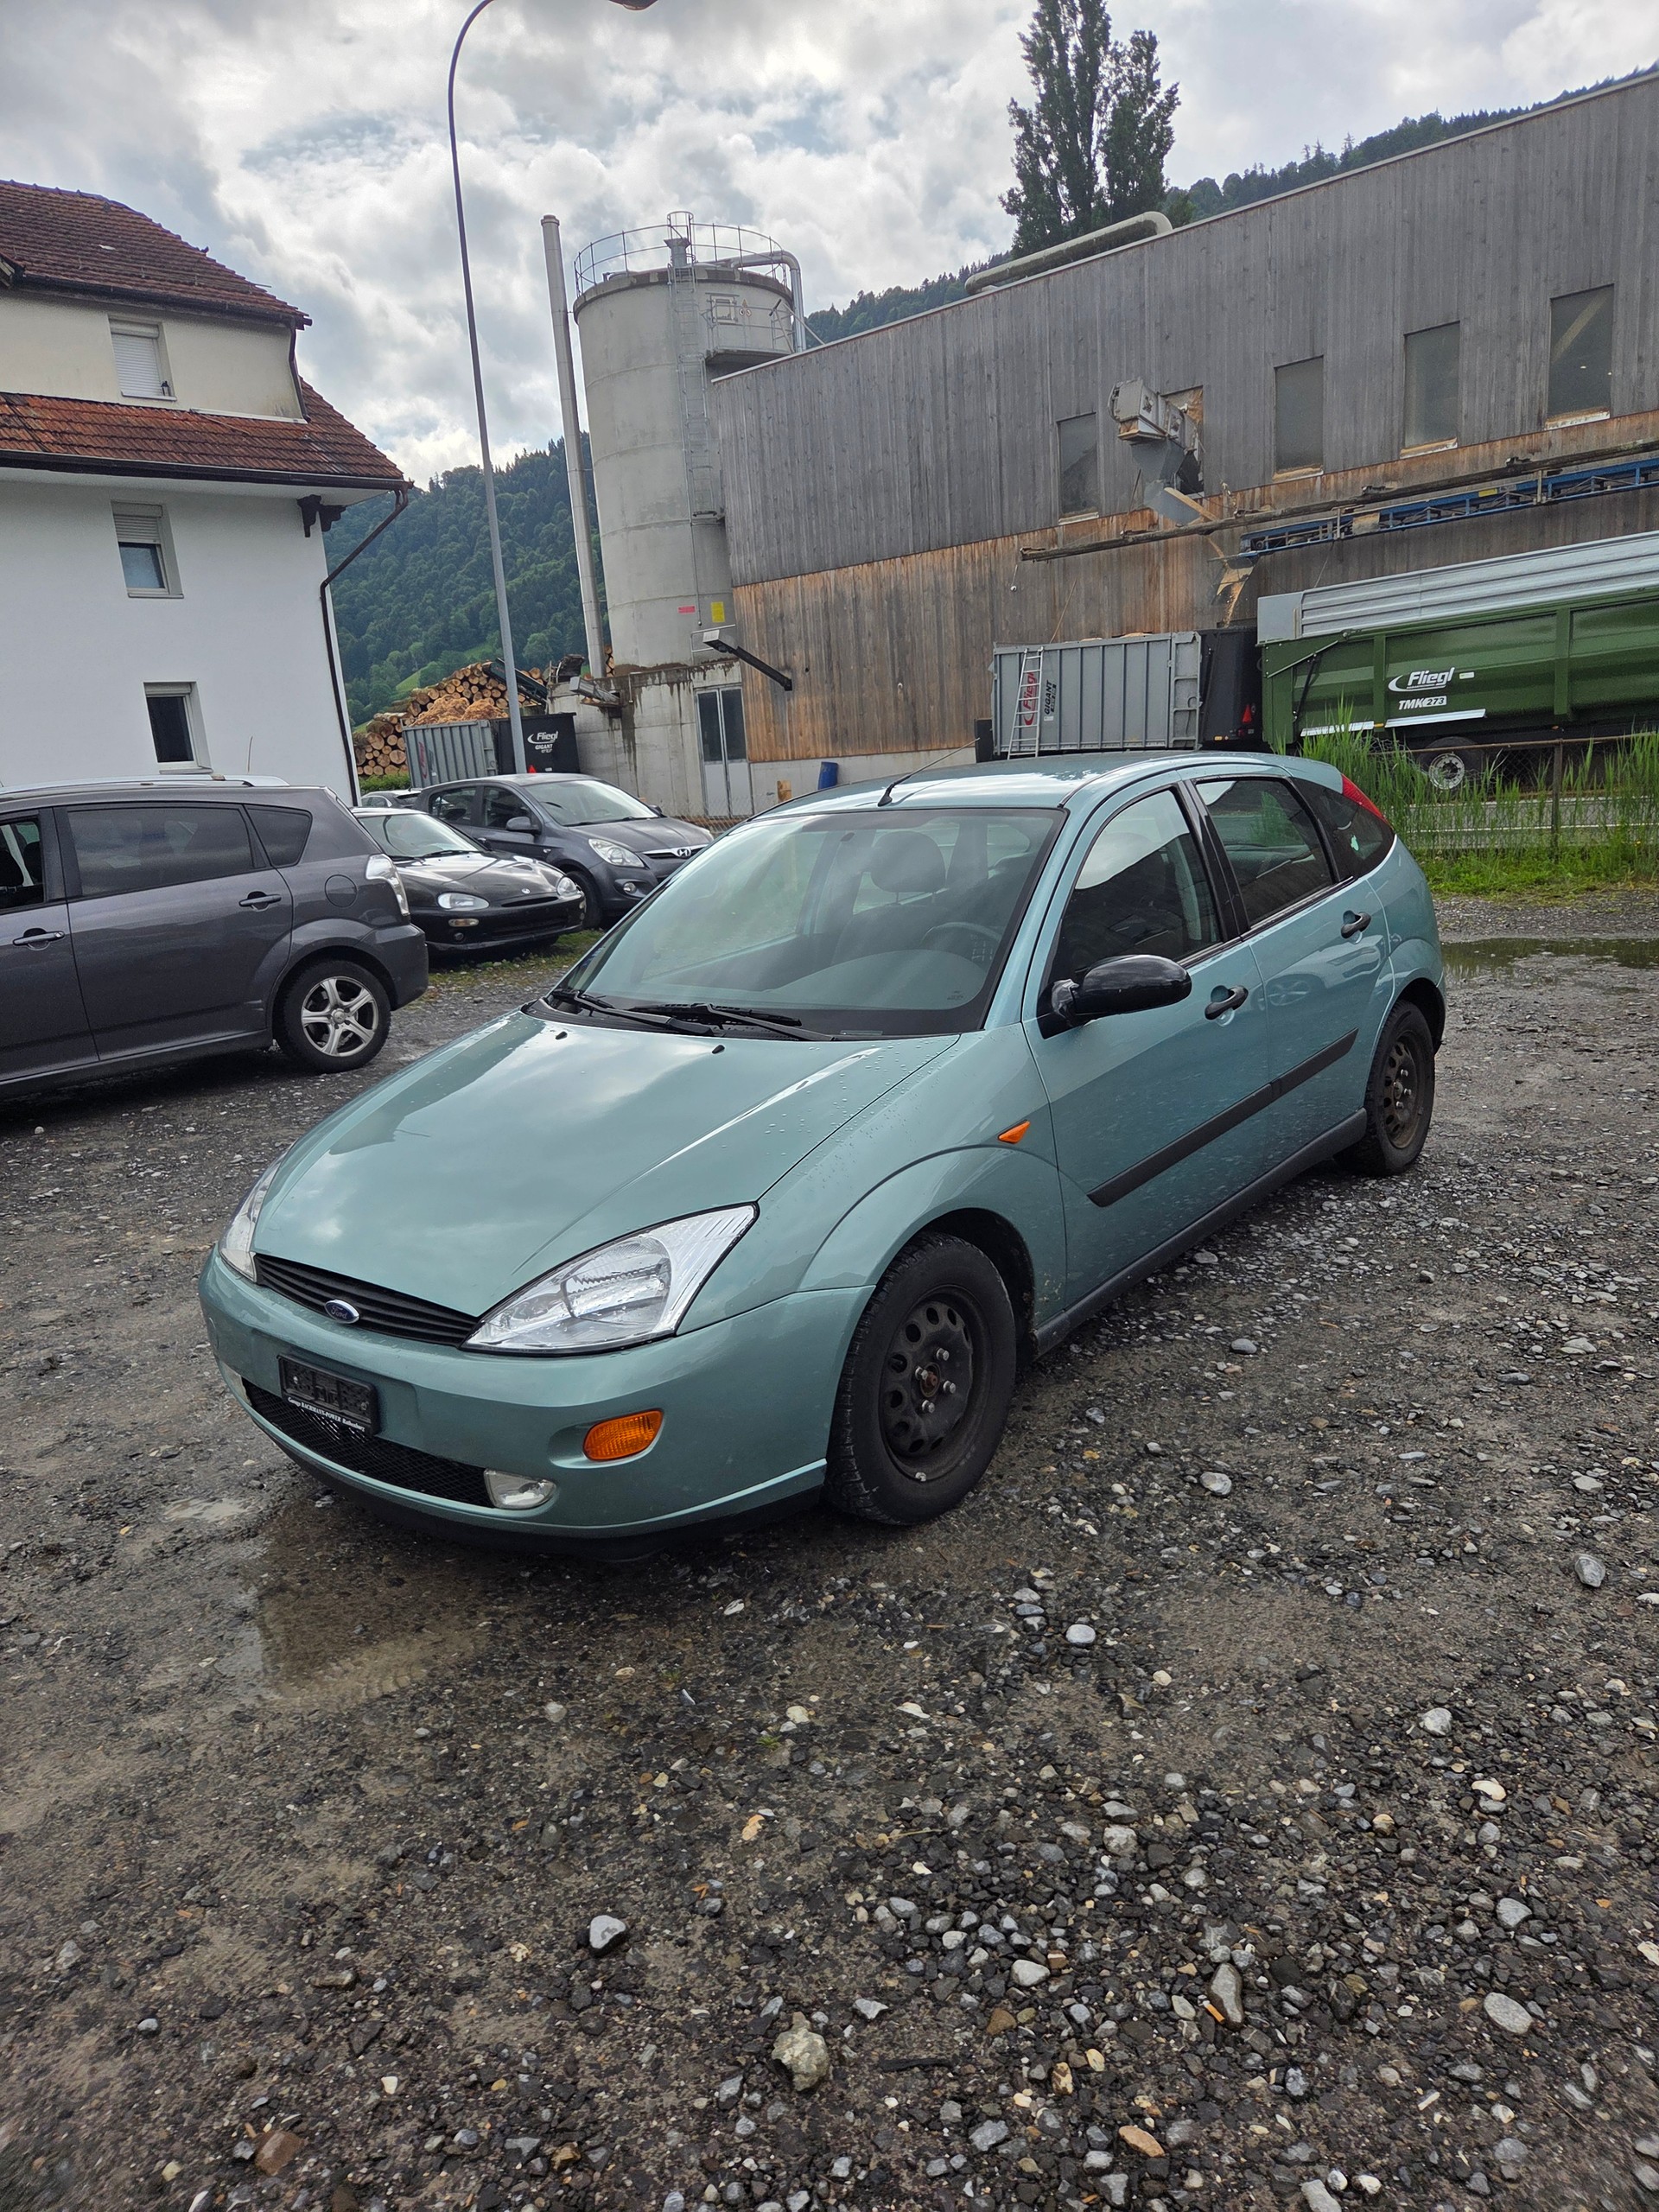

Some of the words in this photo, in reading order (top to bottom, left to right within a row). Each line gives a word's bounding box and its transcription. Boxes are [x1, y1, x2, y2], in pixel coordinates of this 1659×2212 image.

[1407, 667, 1455, 685] Fliegl
[1044, 679, 1052, 715] GIGANT
[1398, 698, 1425, 709] TMK
[537, 730, 559, 742] Fliegl
